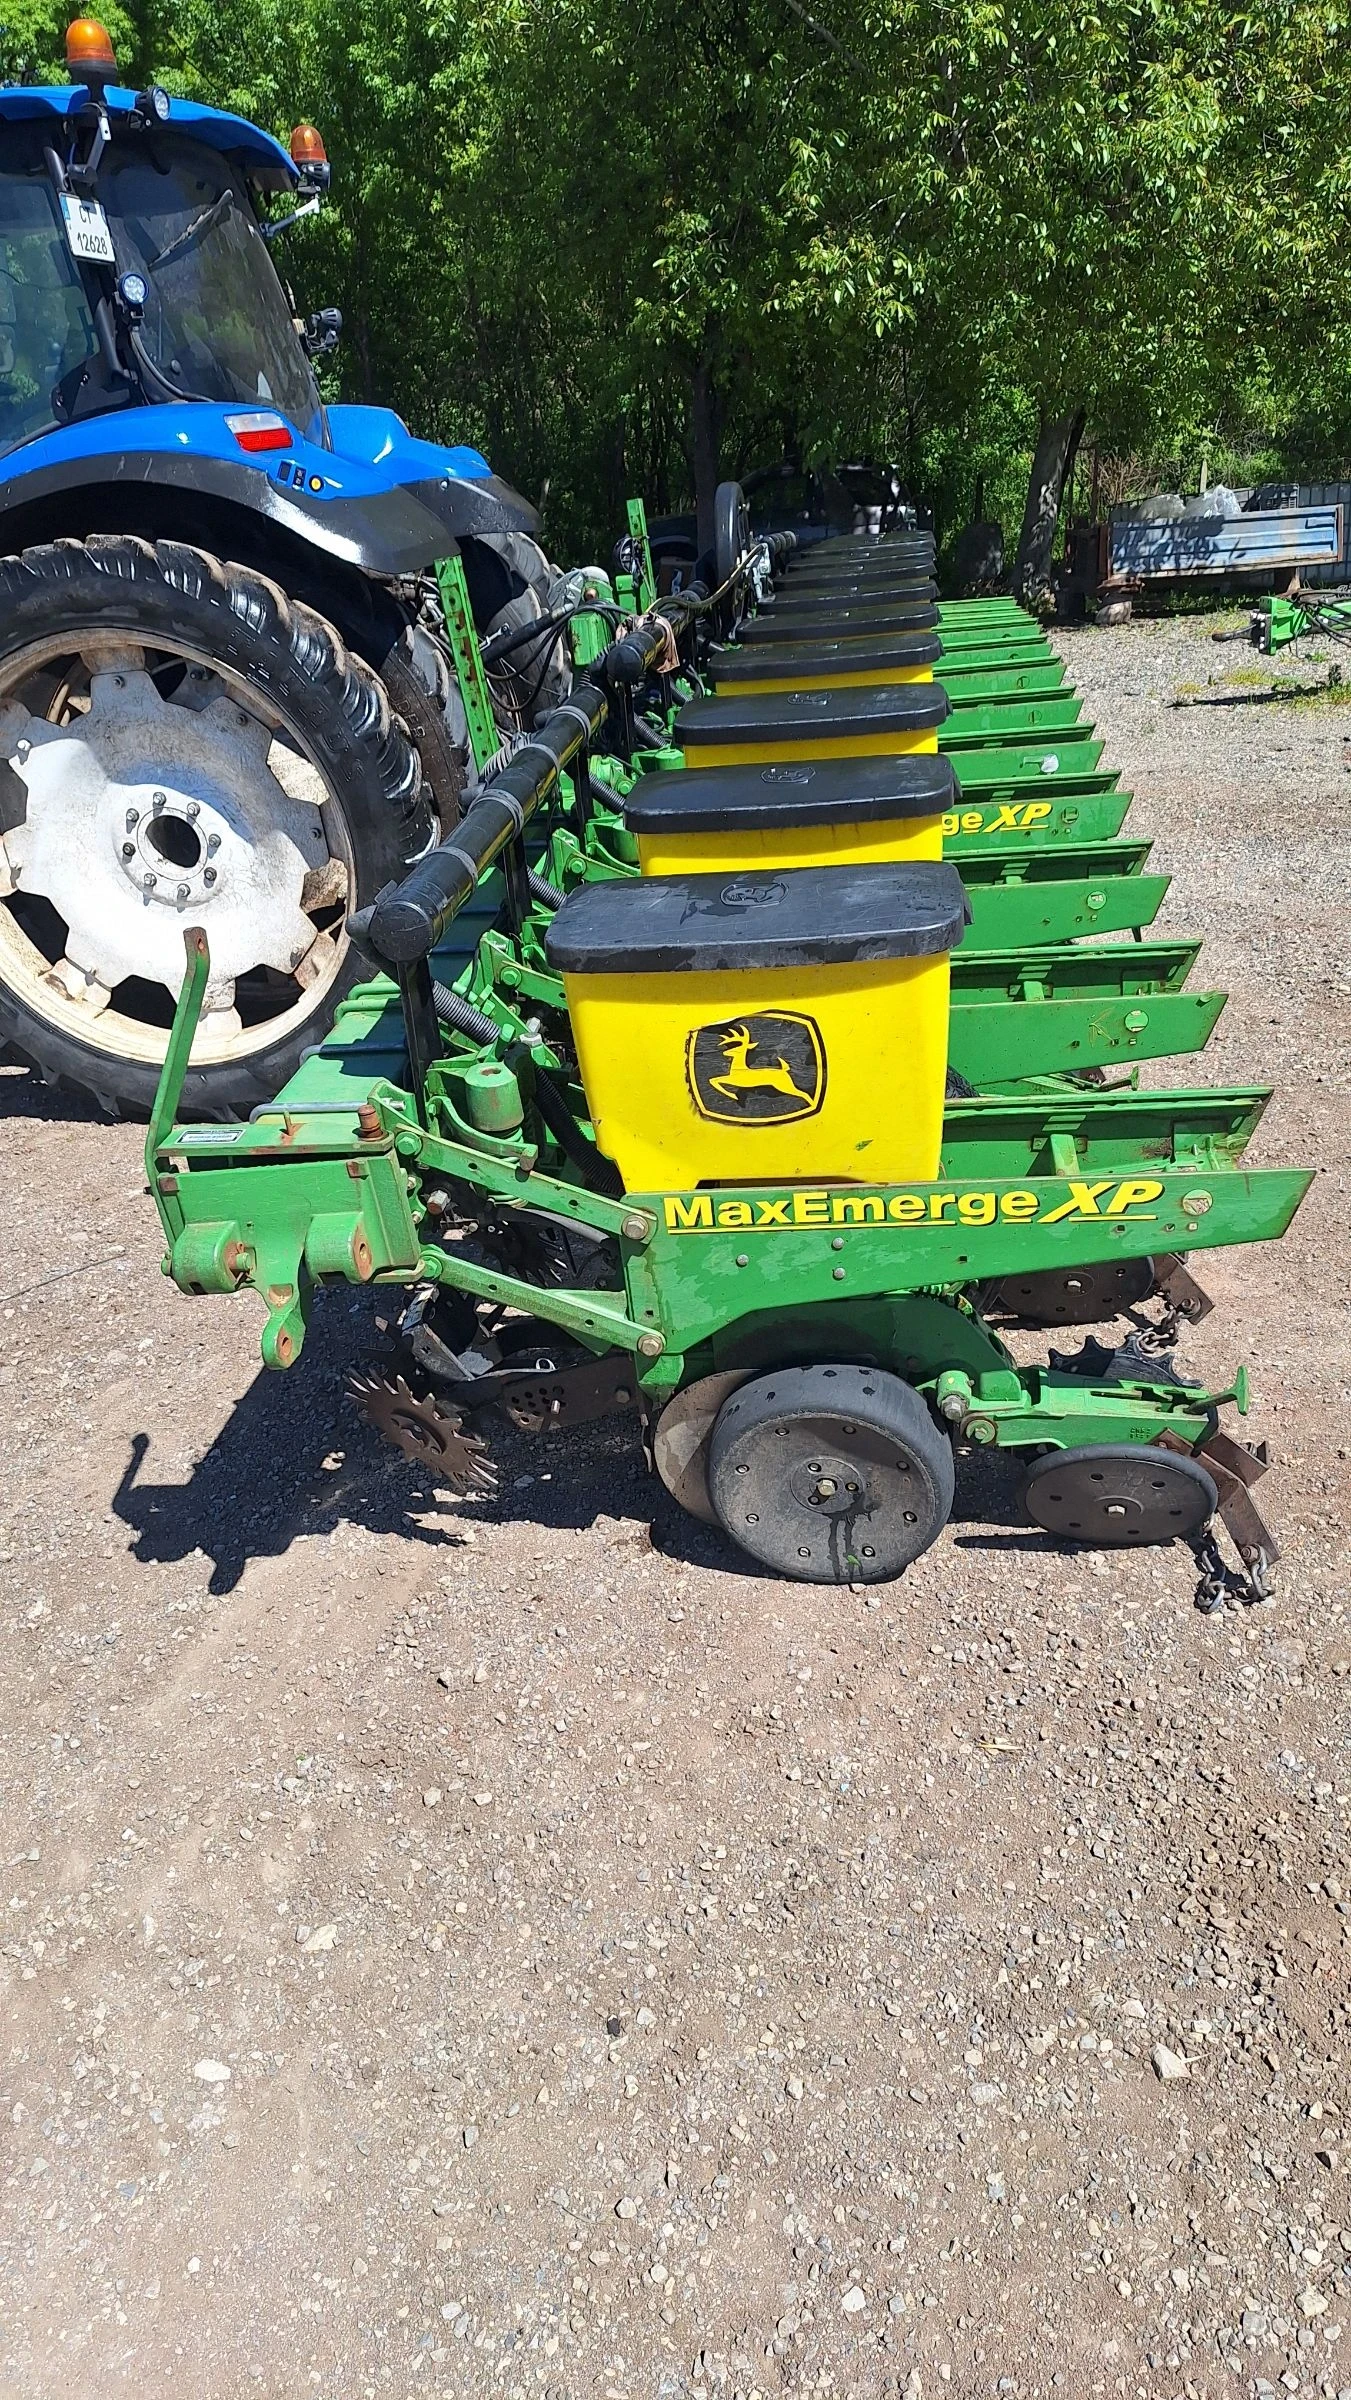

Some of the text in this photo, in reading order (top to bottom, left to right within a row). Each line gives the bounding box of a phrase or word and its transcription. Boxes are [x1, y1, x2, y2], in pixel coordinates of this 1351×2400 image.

[79, 205, 91, 224] CT
[77, 232, 108, 255] 12628
[983, 802, 1053, 833] XP
[663, 1180, 1165, 1228] MaxEmerge XP
